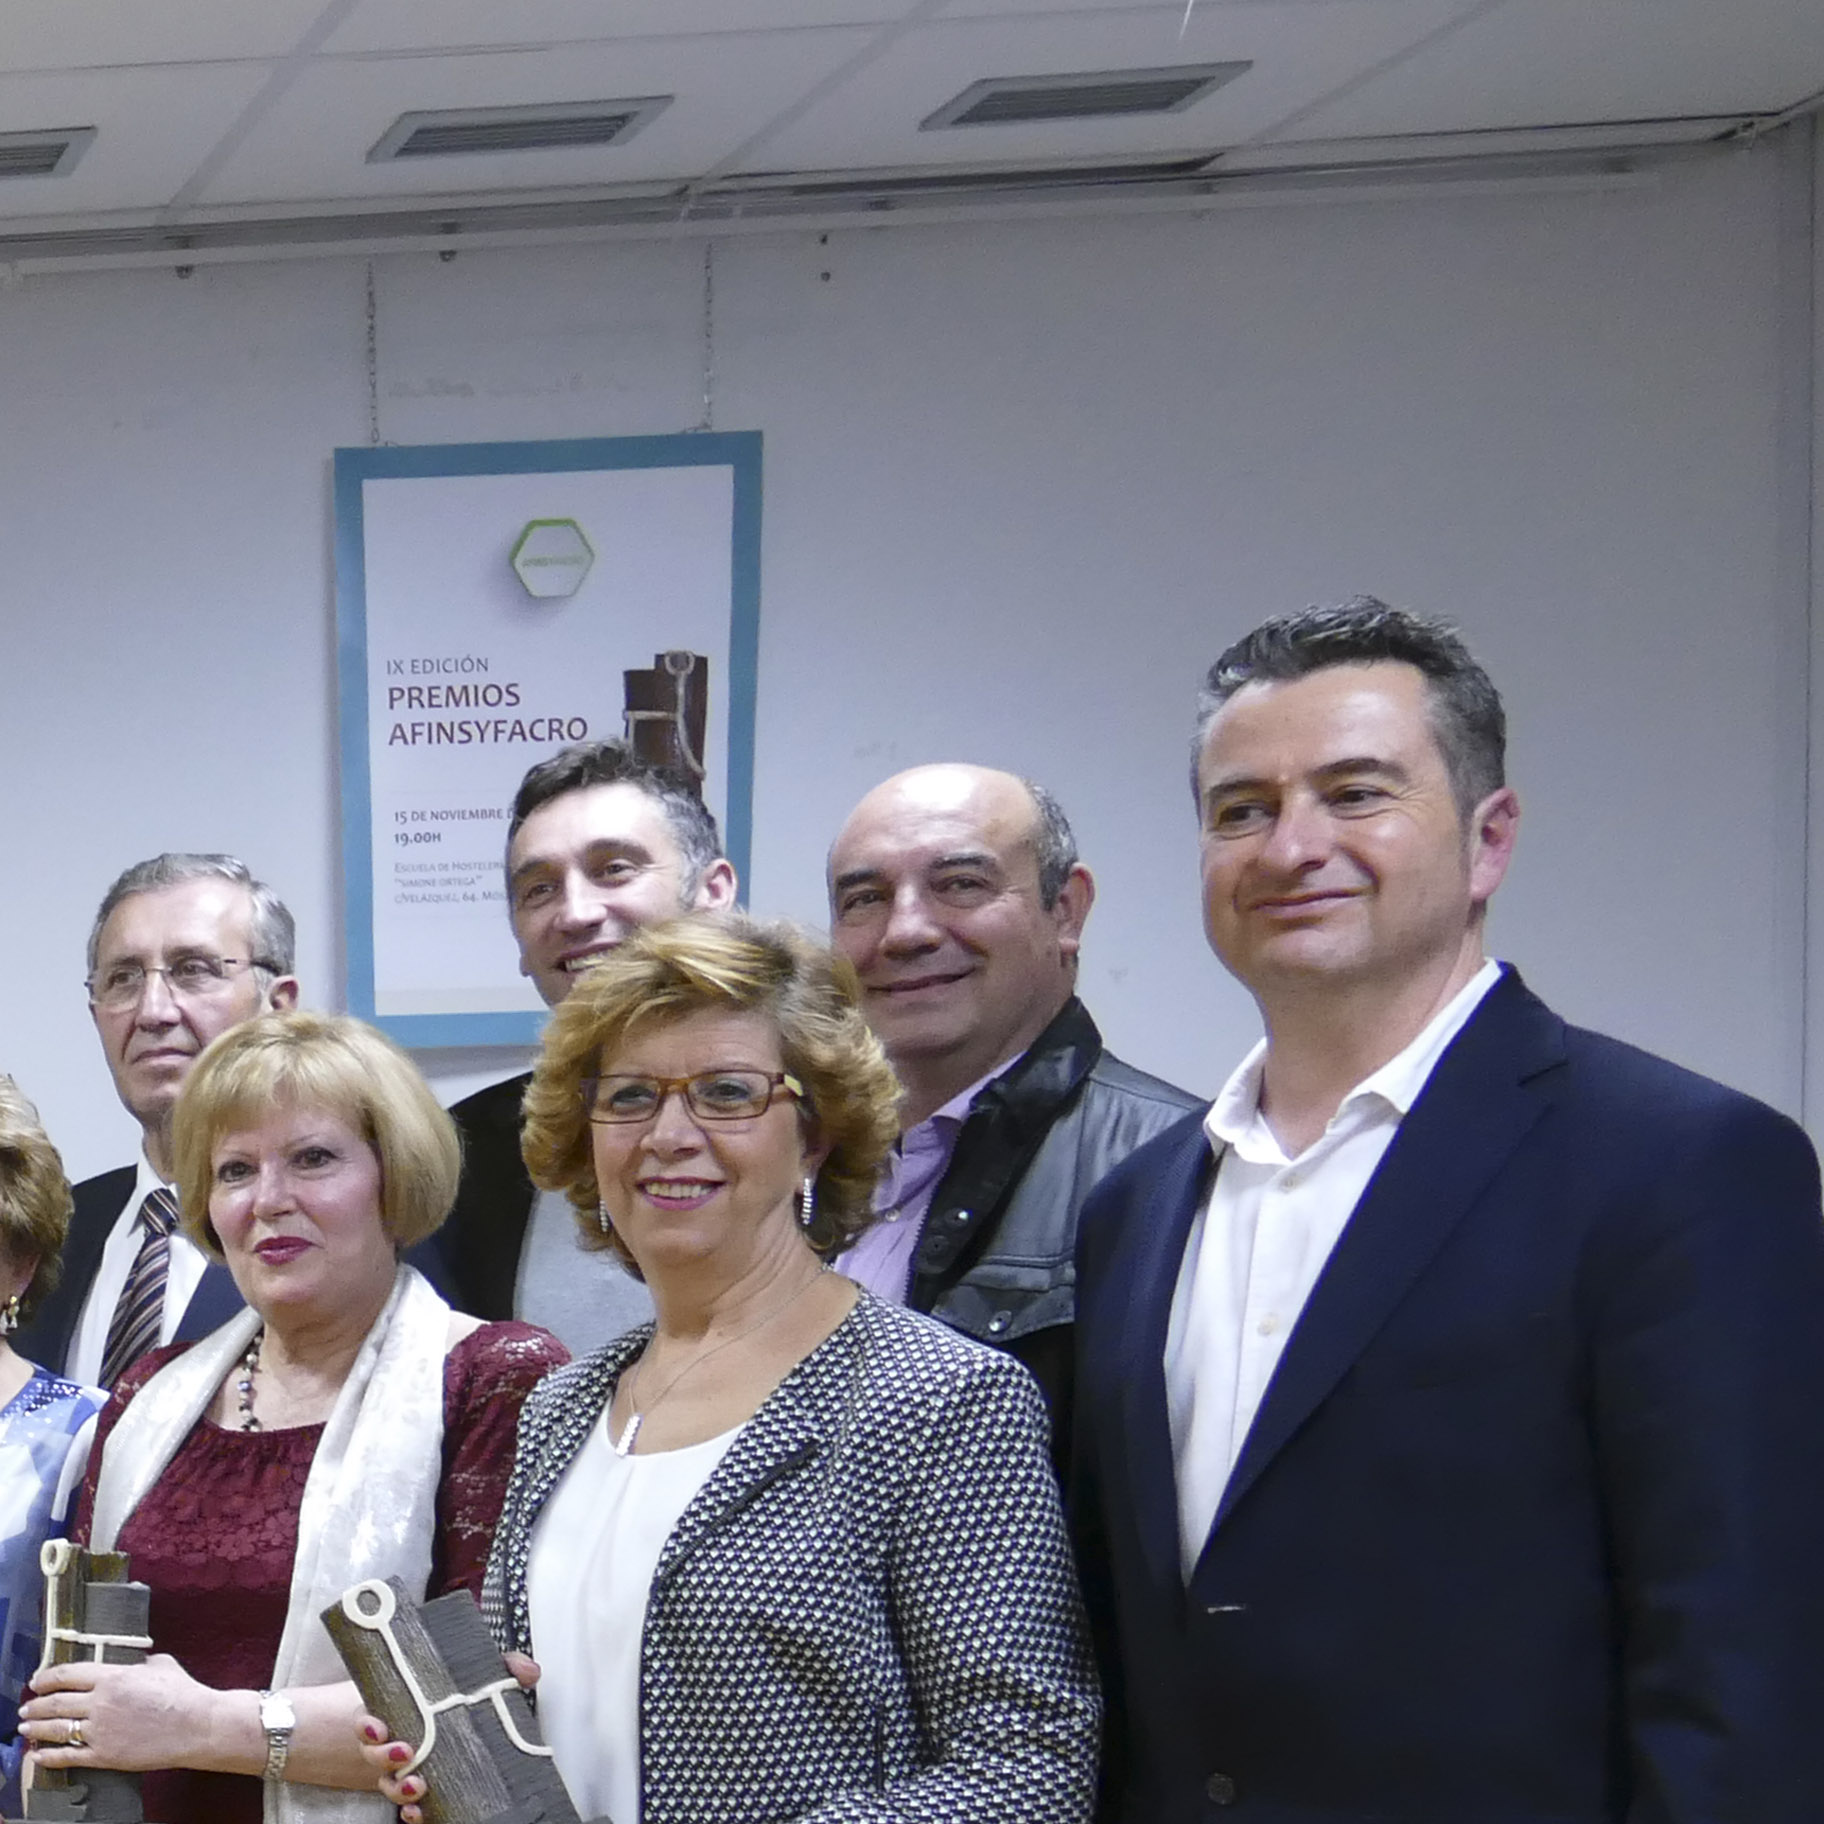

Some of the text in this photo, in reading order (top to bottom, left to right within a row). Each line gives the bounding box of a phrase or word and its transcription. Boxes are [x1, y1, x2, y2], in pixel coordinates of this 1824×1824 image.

[386, 654, 489, 675] IX EDICIÓN
[388, 683, 520, 710] PREMIOS
[388, 717, 588, 746] AFINSYFACRO
[394, 811, 407, 825] 15
[412, 811, 427, 821] DE
[430, 808, 503, 820] NOVIEMBRE
